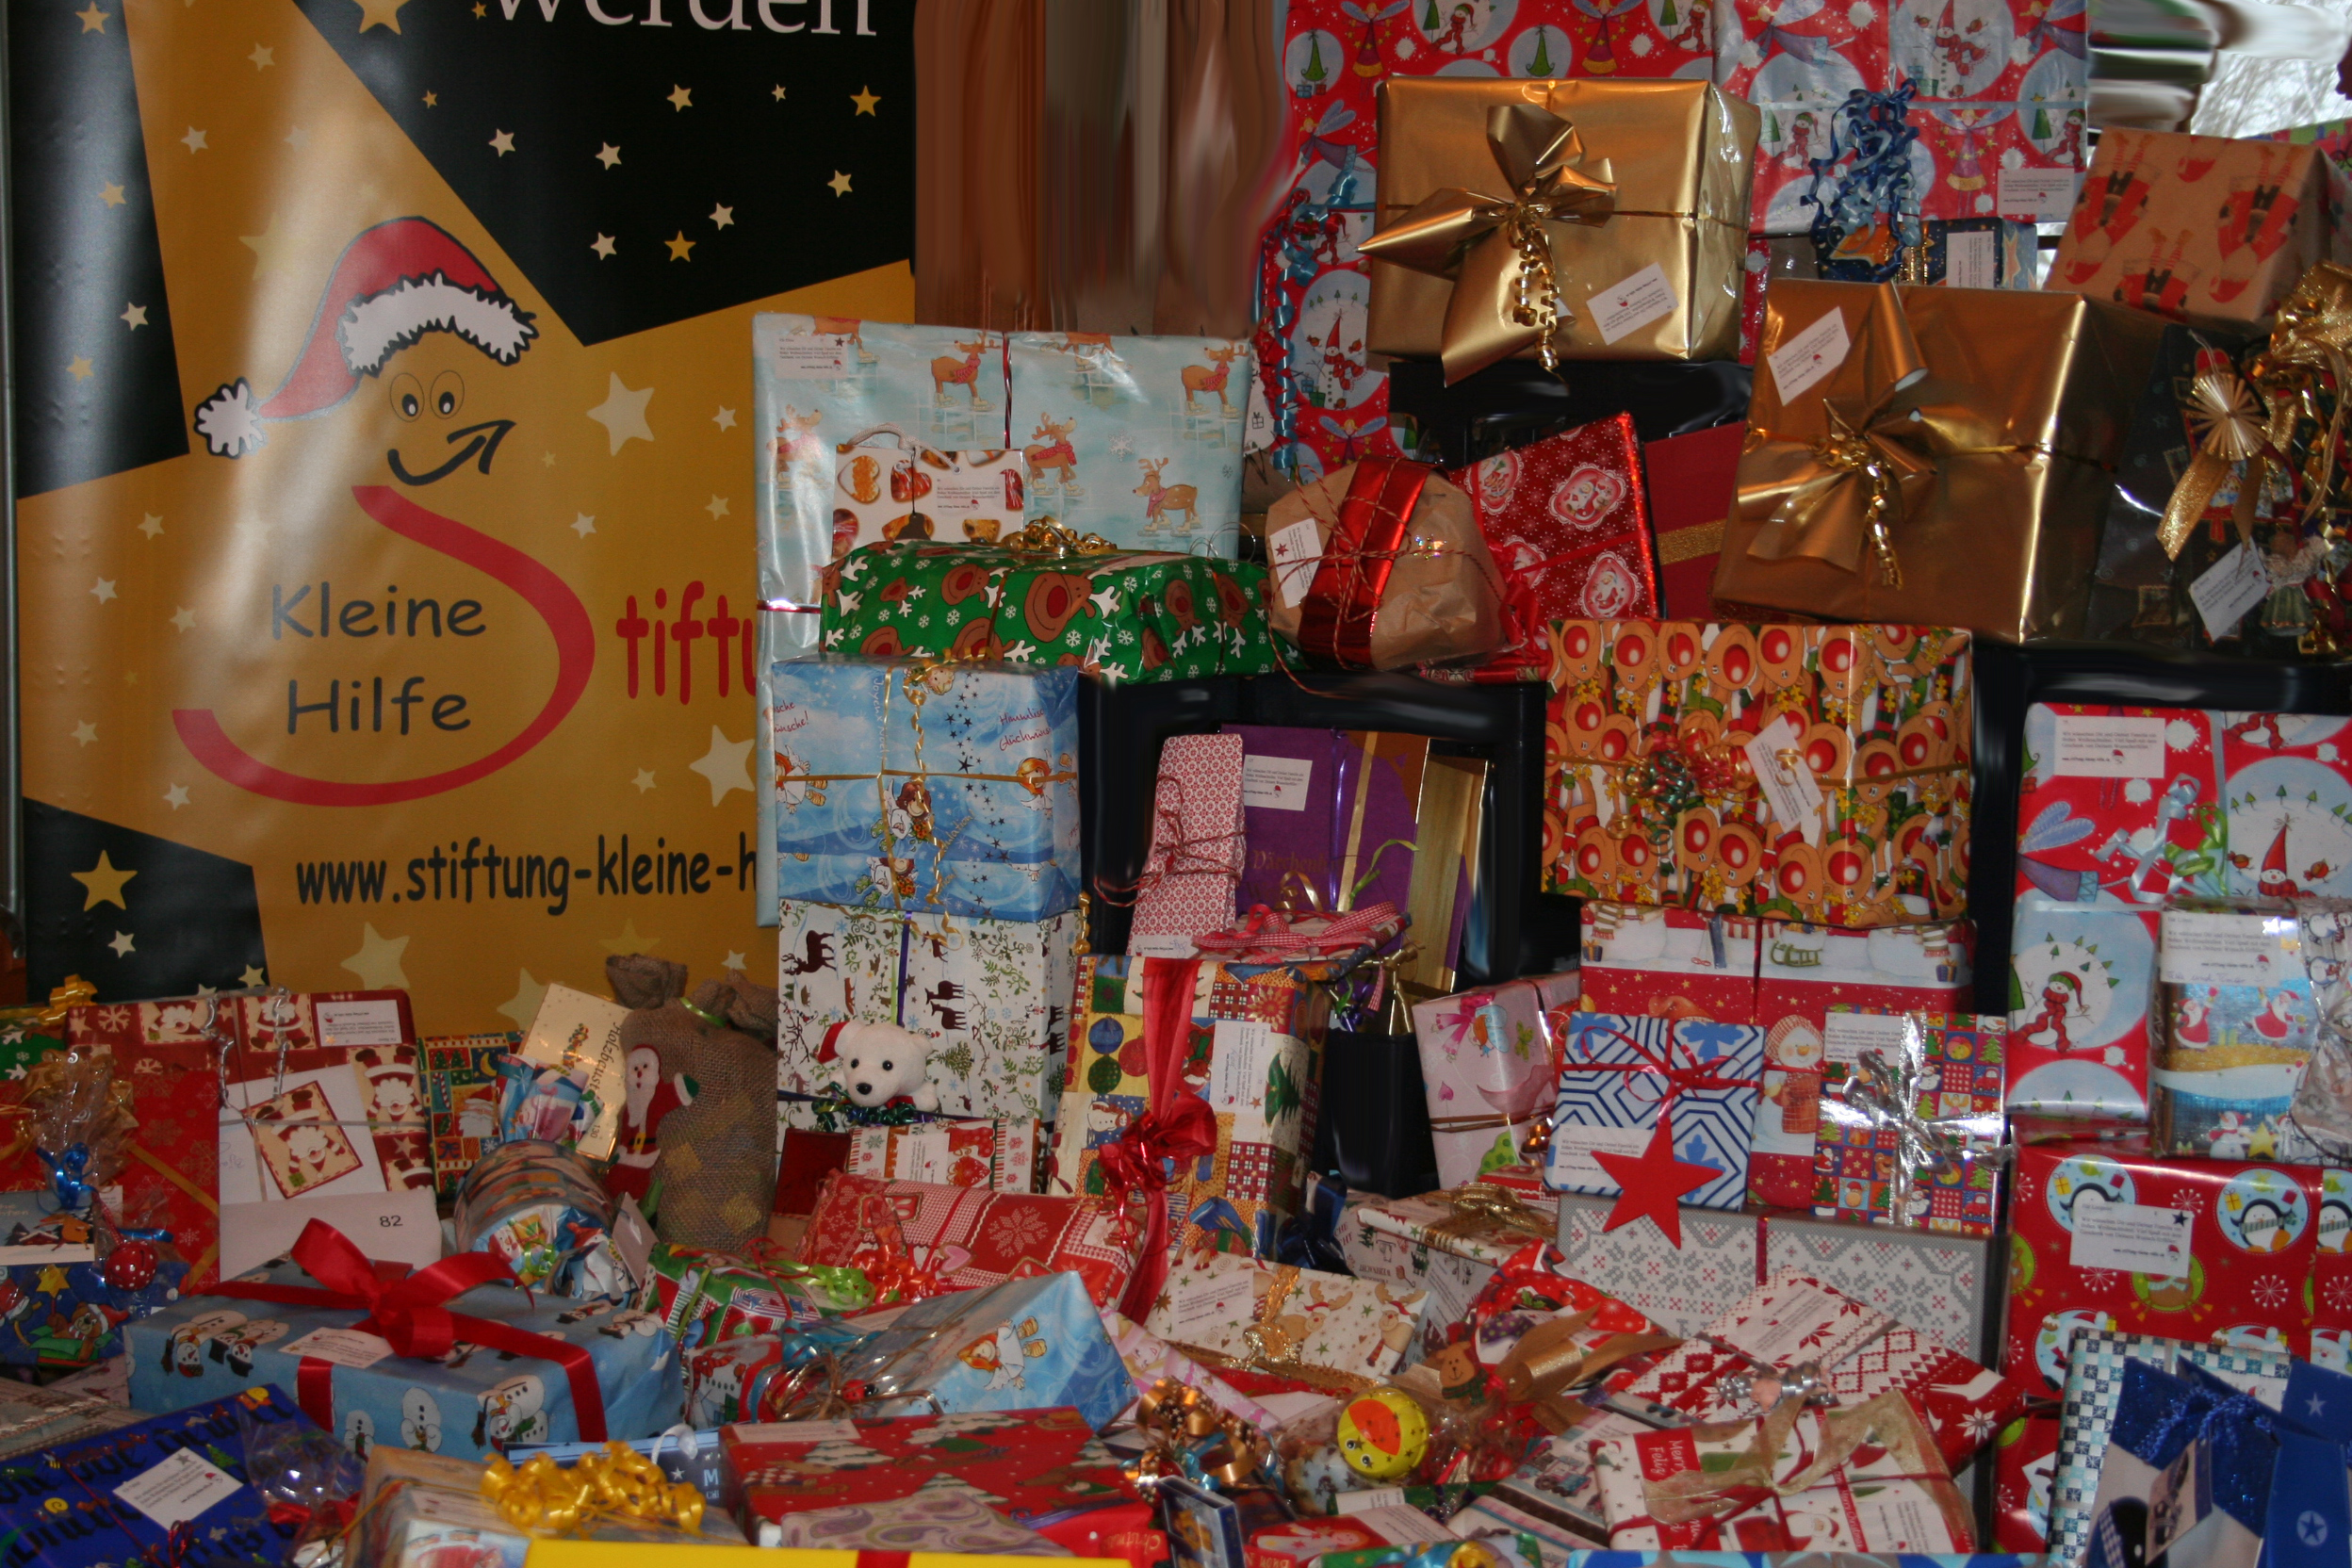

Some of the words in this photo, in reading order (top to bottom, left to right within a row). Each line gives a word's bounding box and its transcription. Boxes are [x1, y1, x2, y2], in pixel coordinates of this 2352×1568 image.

[272, 580, 487, 641] Kleine
[287, 676, 471, 736] Hilfe
[379, 1215, 403, 1228] 82
